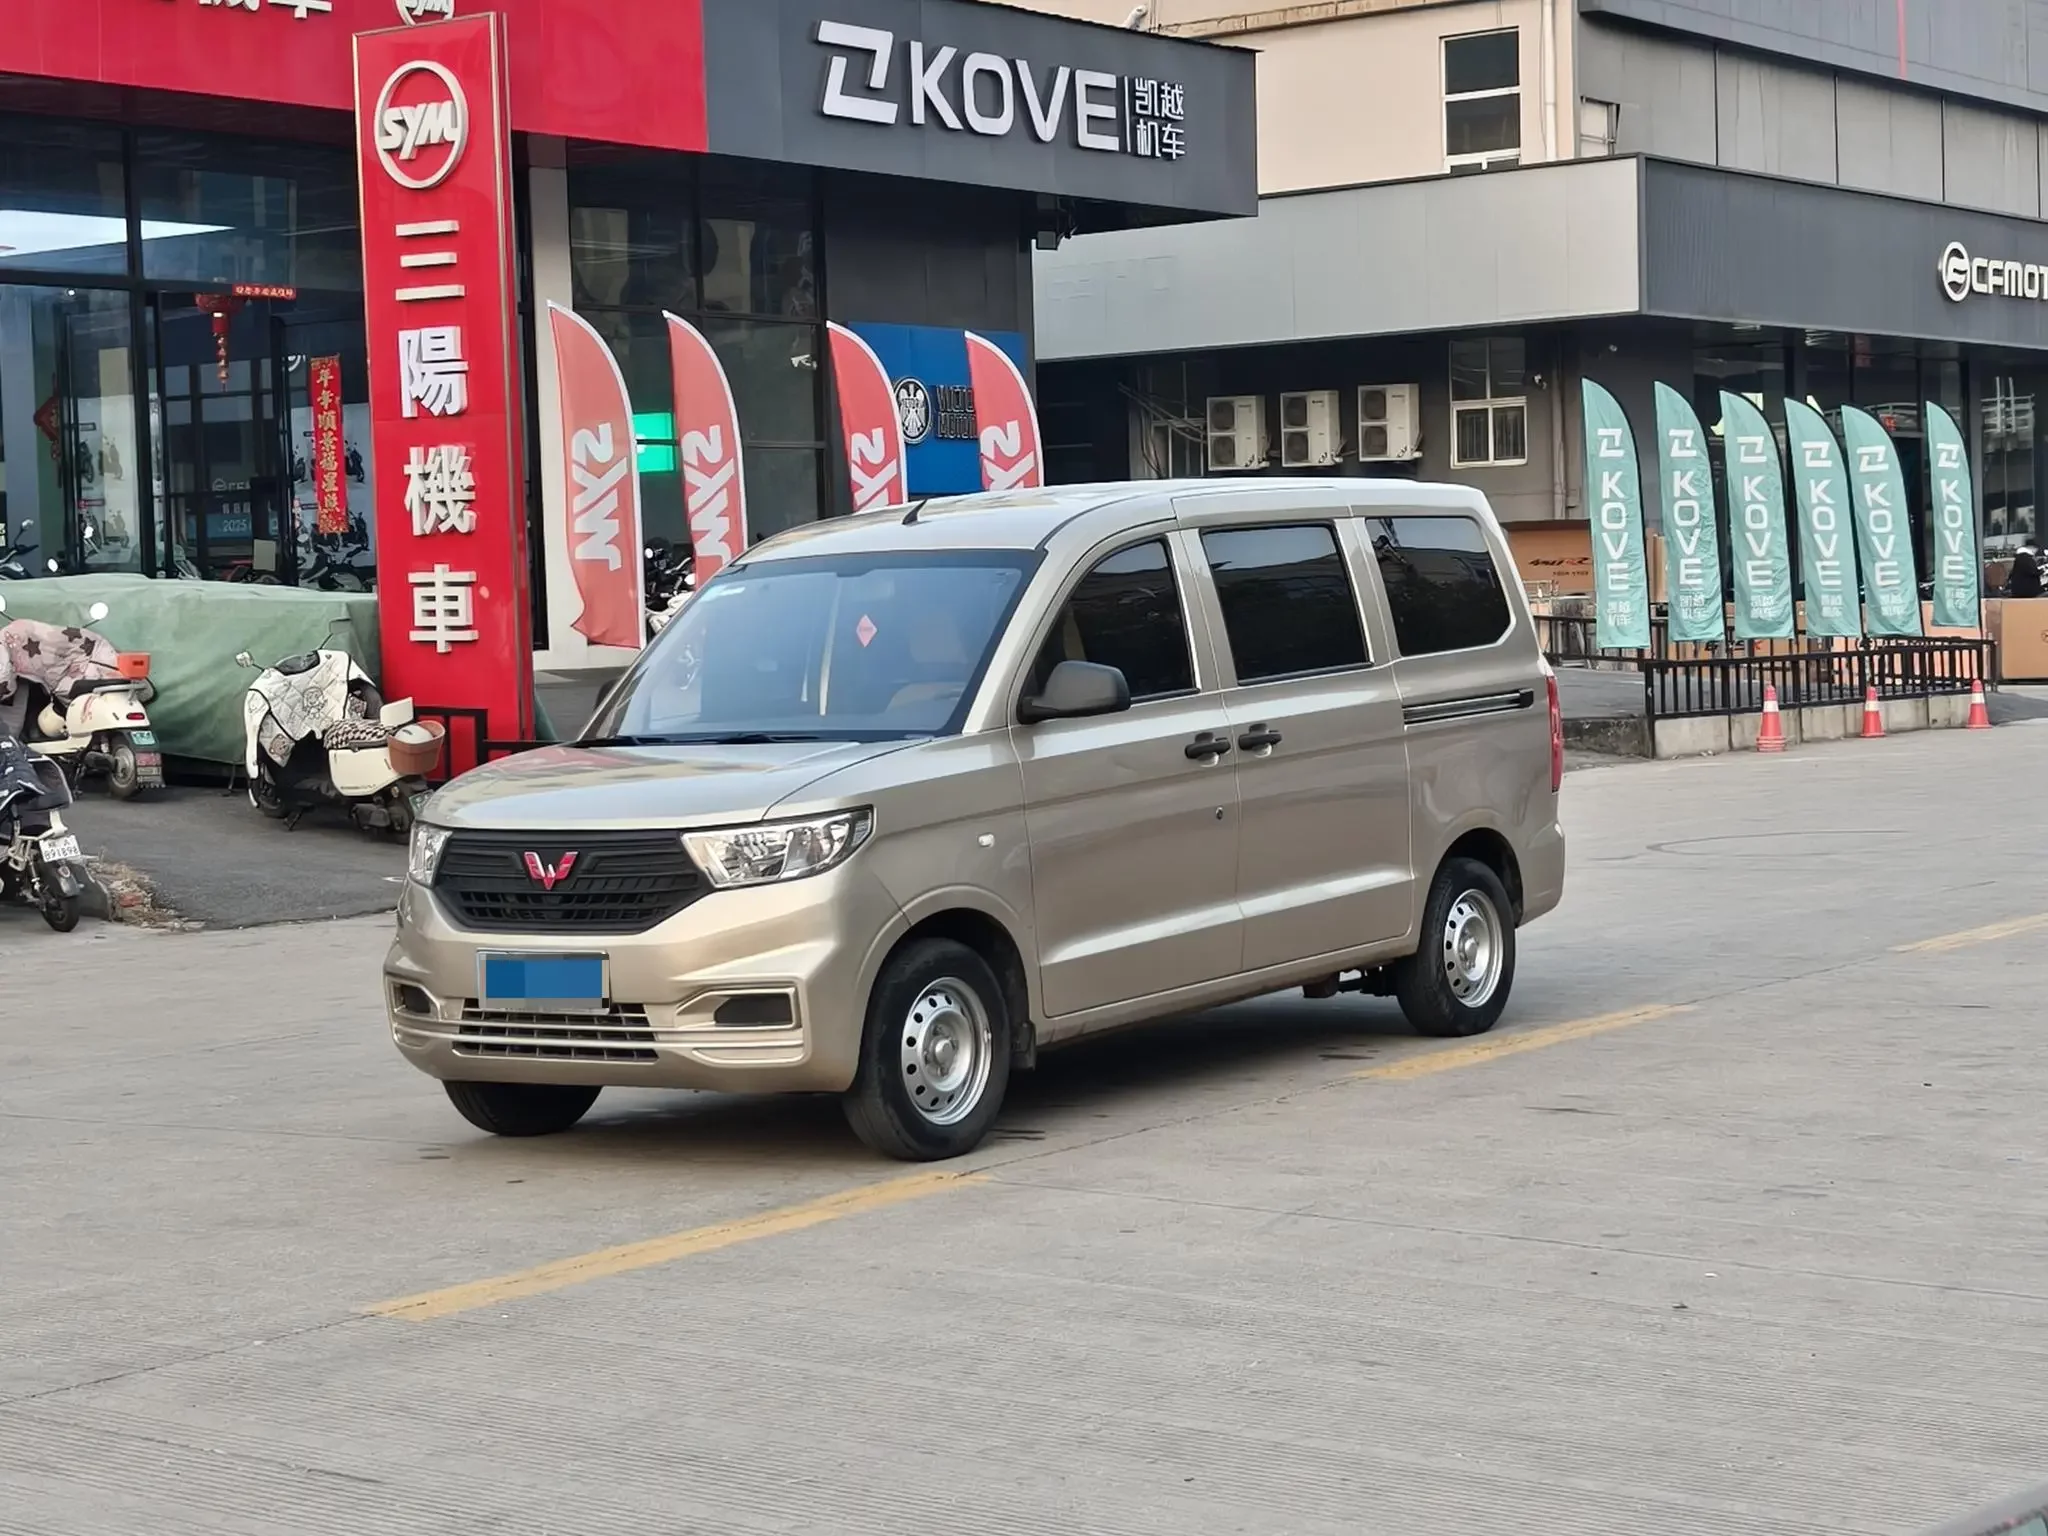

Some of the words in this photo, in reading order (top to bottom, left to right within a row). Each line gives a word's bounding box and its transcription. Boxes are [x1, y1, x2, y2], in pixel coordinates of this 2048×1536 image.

[379, 101, 458, 160] SYM
[909, 40, 1120, 151] KOVE
[1135, 77, 1184, 120] 凯越
[1136, 118, 1185, 160] 机车
[394, 219, 479, 654] 三陽機車
[1601, 470, 1630, 592] KOVE
[1672, 470, 1703, 585] KOVE
[1743, 475, 1773, 586] KOVE
[1809, 479, 1842, 586] KOVE
[1863, 482, 1900, 587] KOVE
[1939, 479, 1966, 580] KOVE
